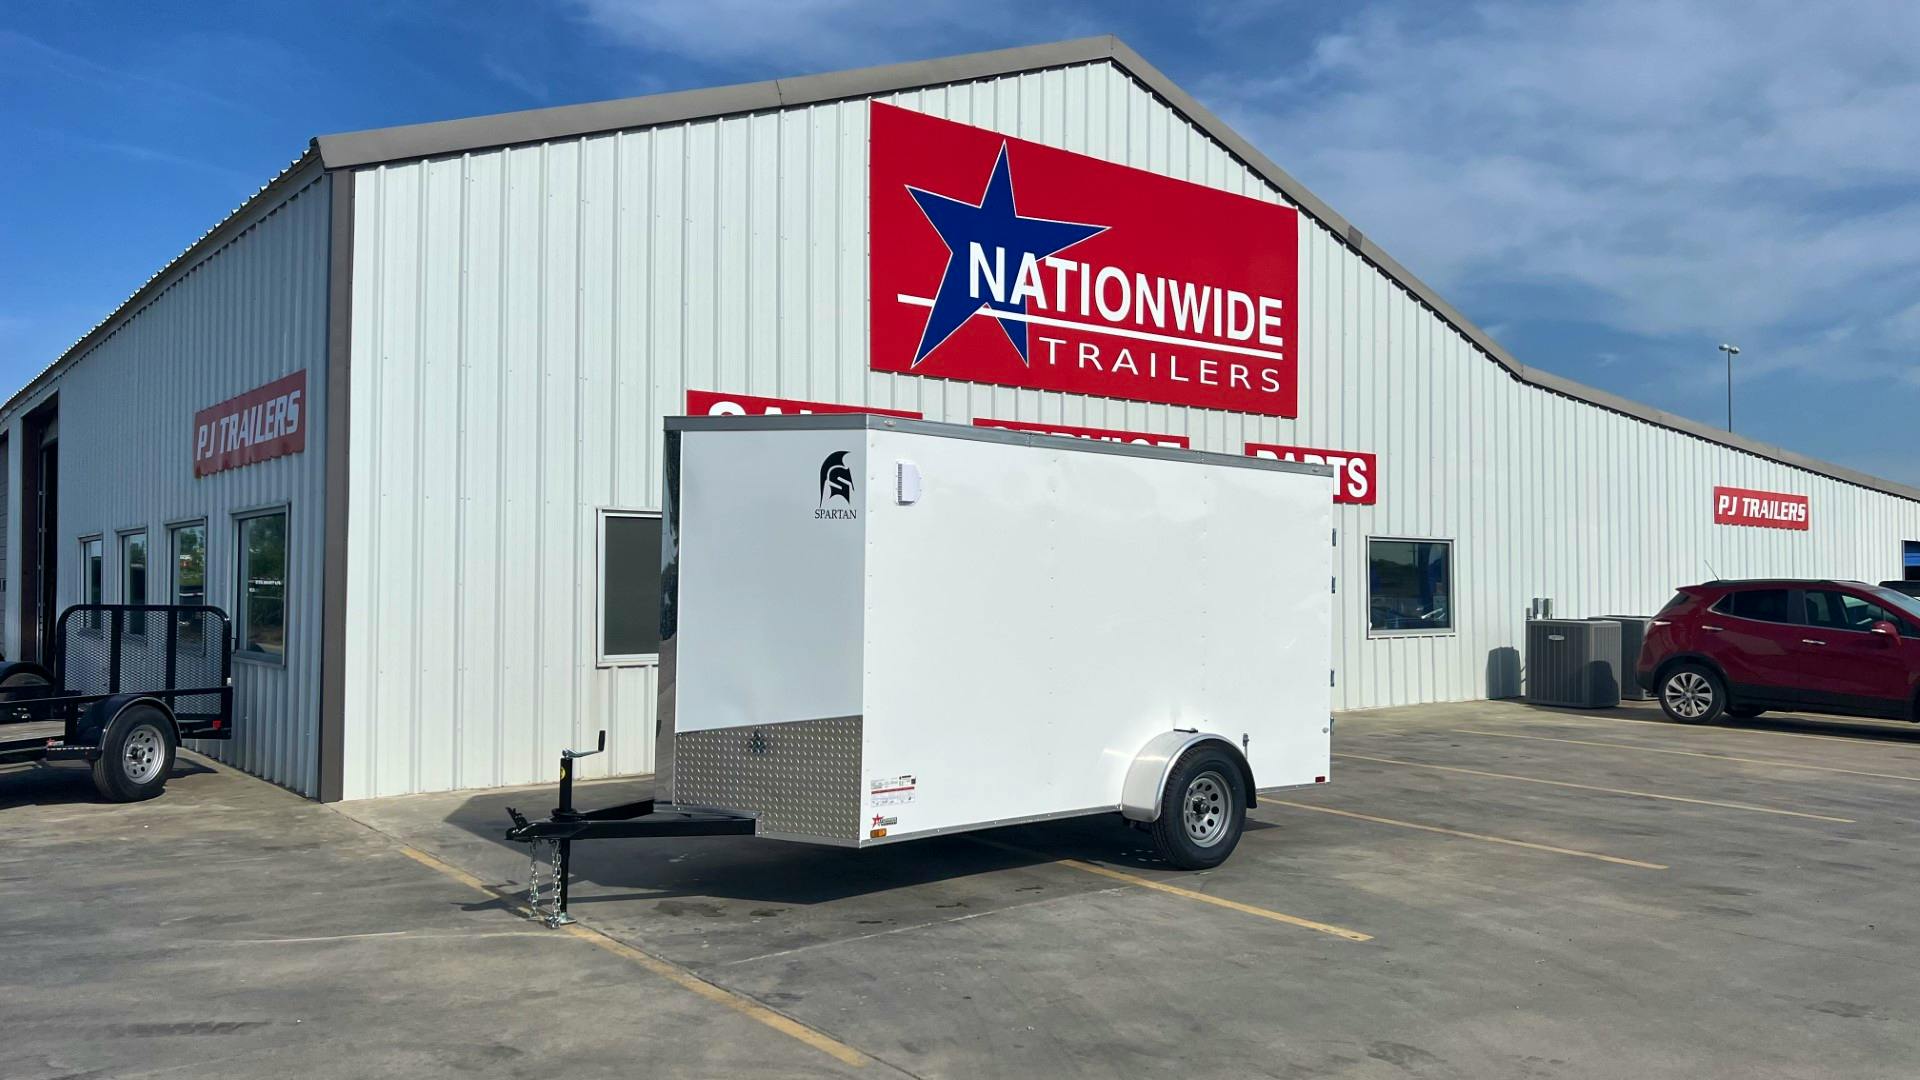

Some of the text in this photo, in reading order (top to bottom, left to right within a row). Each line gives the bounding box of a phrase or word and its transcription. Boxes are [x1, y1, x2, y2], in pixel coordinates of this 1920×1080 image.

[969, 241, 1284, 347] NATIONWIDE
[1038, 336, 1281, 393] TRAILERS
[196, 390, 301, 461] PJ TRAILERS
[814, 508, 857, 520] SPARTAN
[1718, 494, 1807, 522] PJ TRAILERS
